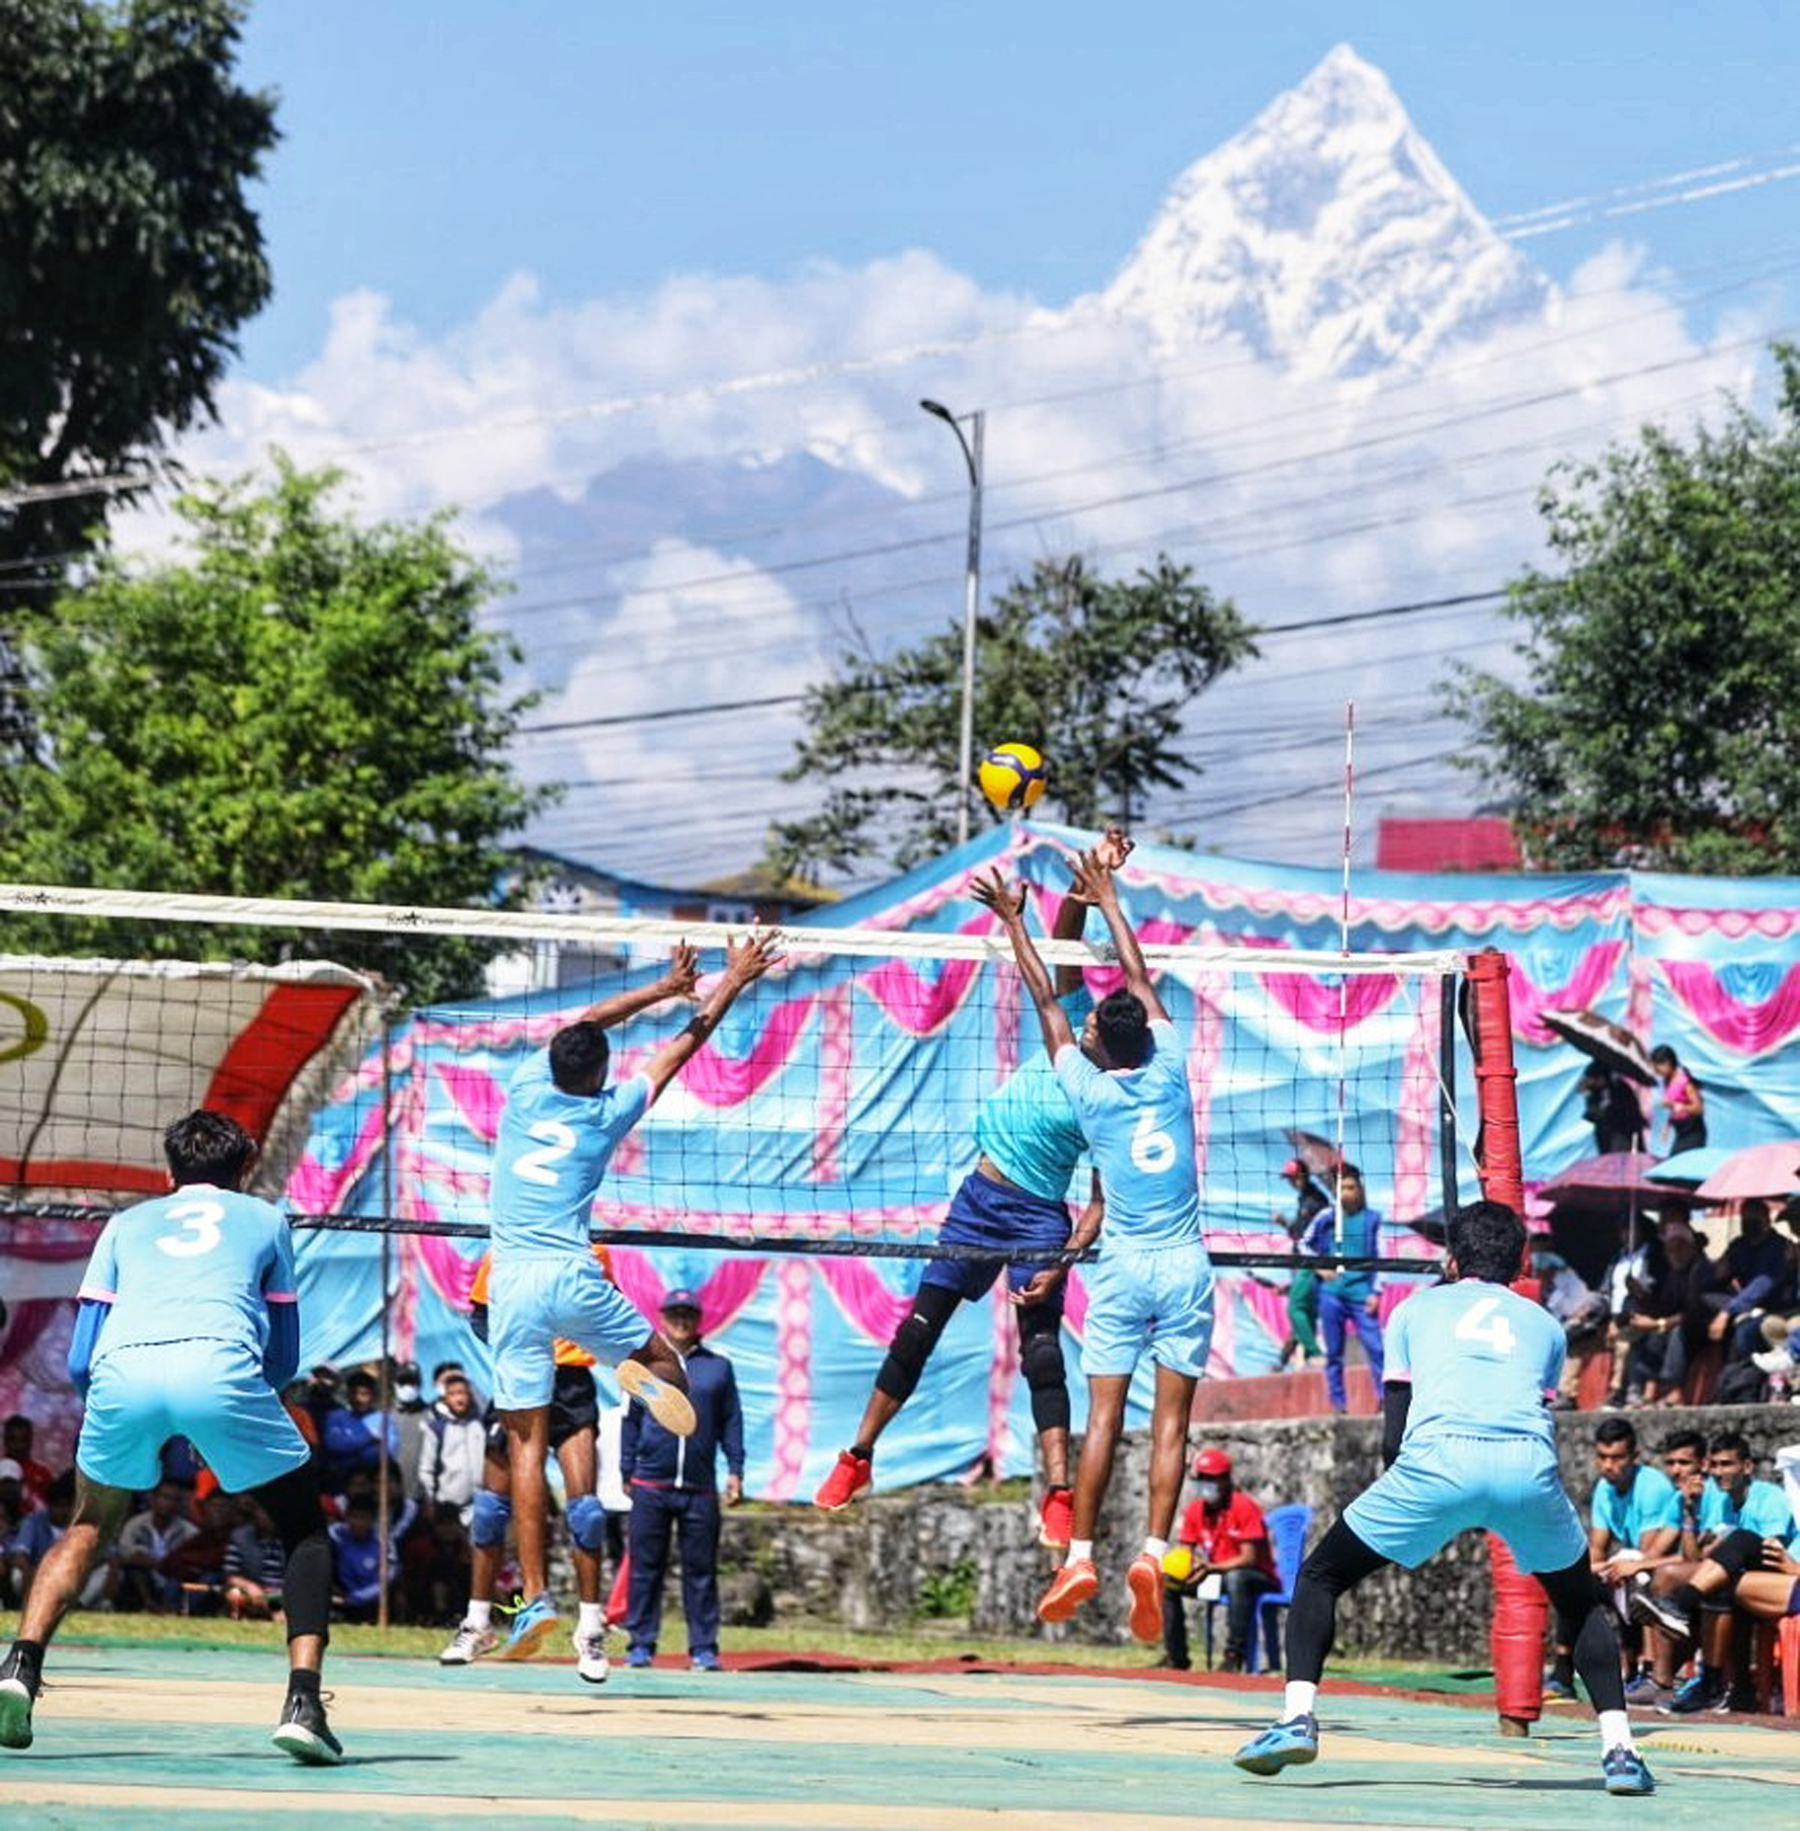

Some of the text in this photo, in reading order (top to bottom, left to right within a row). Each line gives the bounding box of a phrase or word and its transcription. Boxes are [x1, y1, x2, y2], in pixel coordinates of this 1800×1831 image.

[513, 1121, 577, 1186] 2
[1131, 1110, 1176, 1173] 6
[156, 1201, 225, 1258] 3
[1455, 1296, 1517, 1355] 4
